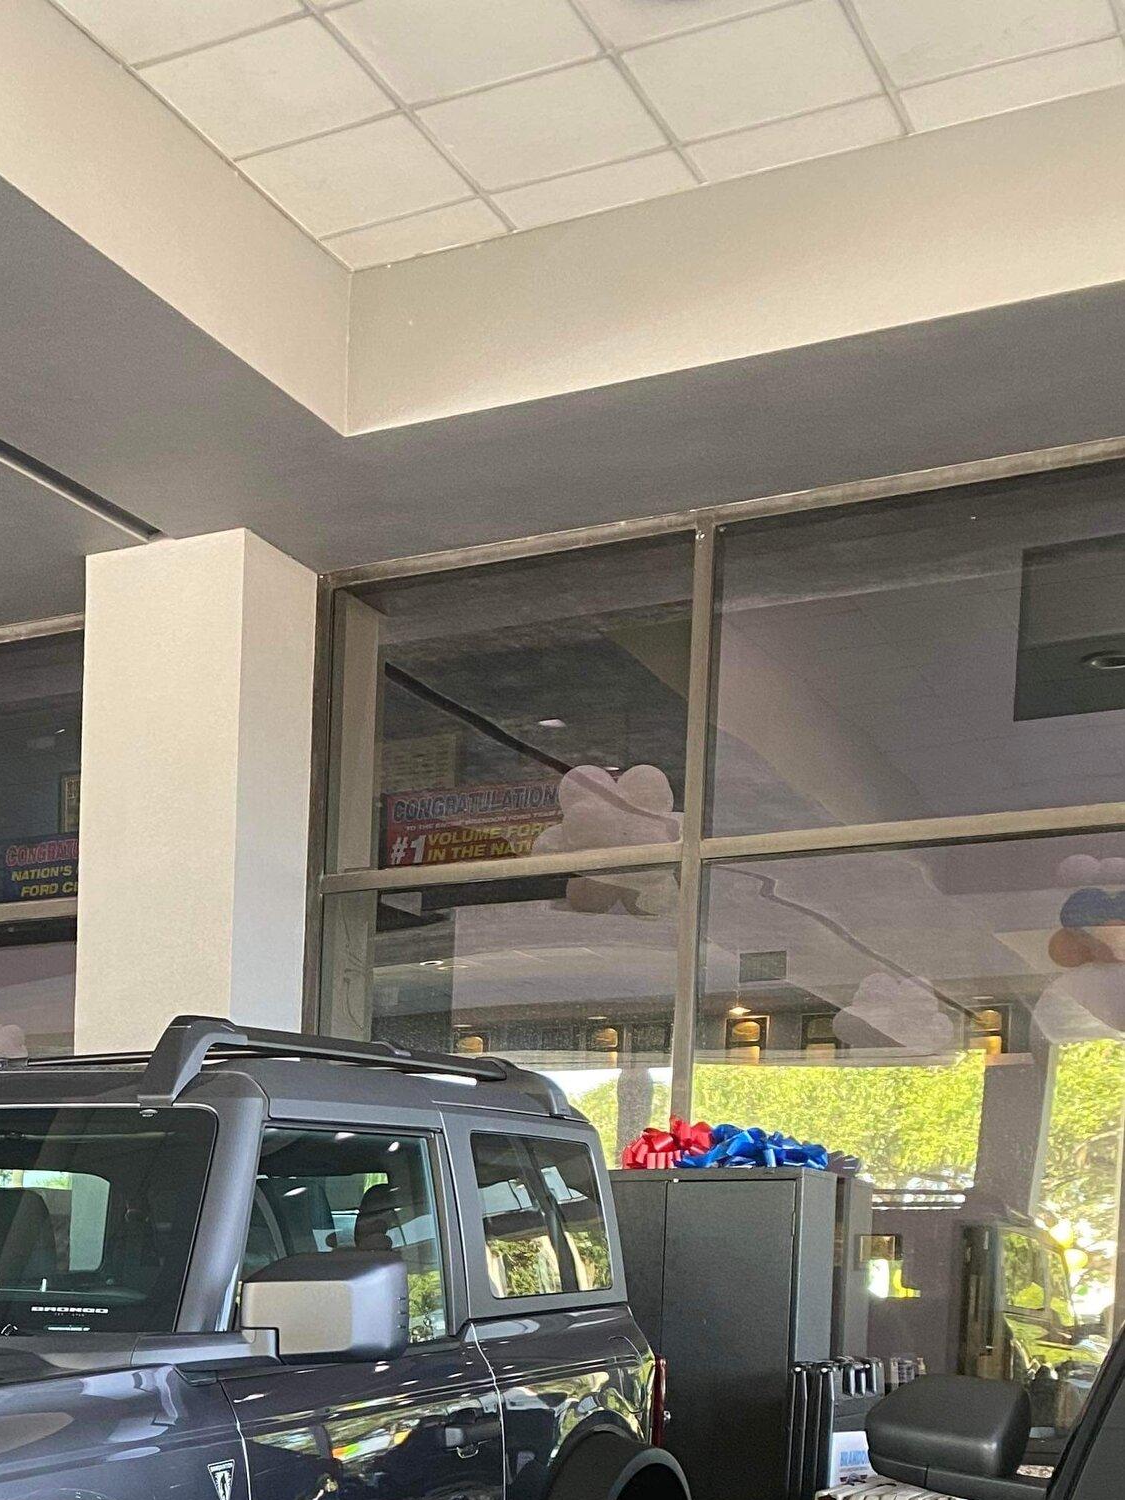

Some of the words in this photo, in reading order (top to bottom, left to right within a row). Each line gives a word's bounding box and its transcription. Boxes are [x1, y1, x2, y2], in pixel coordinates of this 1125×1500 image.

[393, 783, 562, 823] CONGRATULATION
[428, 825, 501, 846] VOLUME
[506, 821, 546, 837] FOR
[450, 844, 484, 858] THE
[490, 839, 533, 855] NATI
[20, 883, 59, 897] FORD
